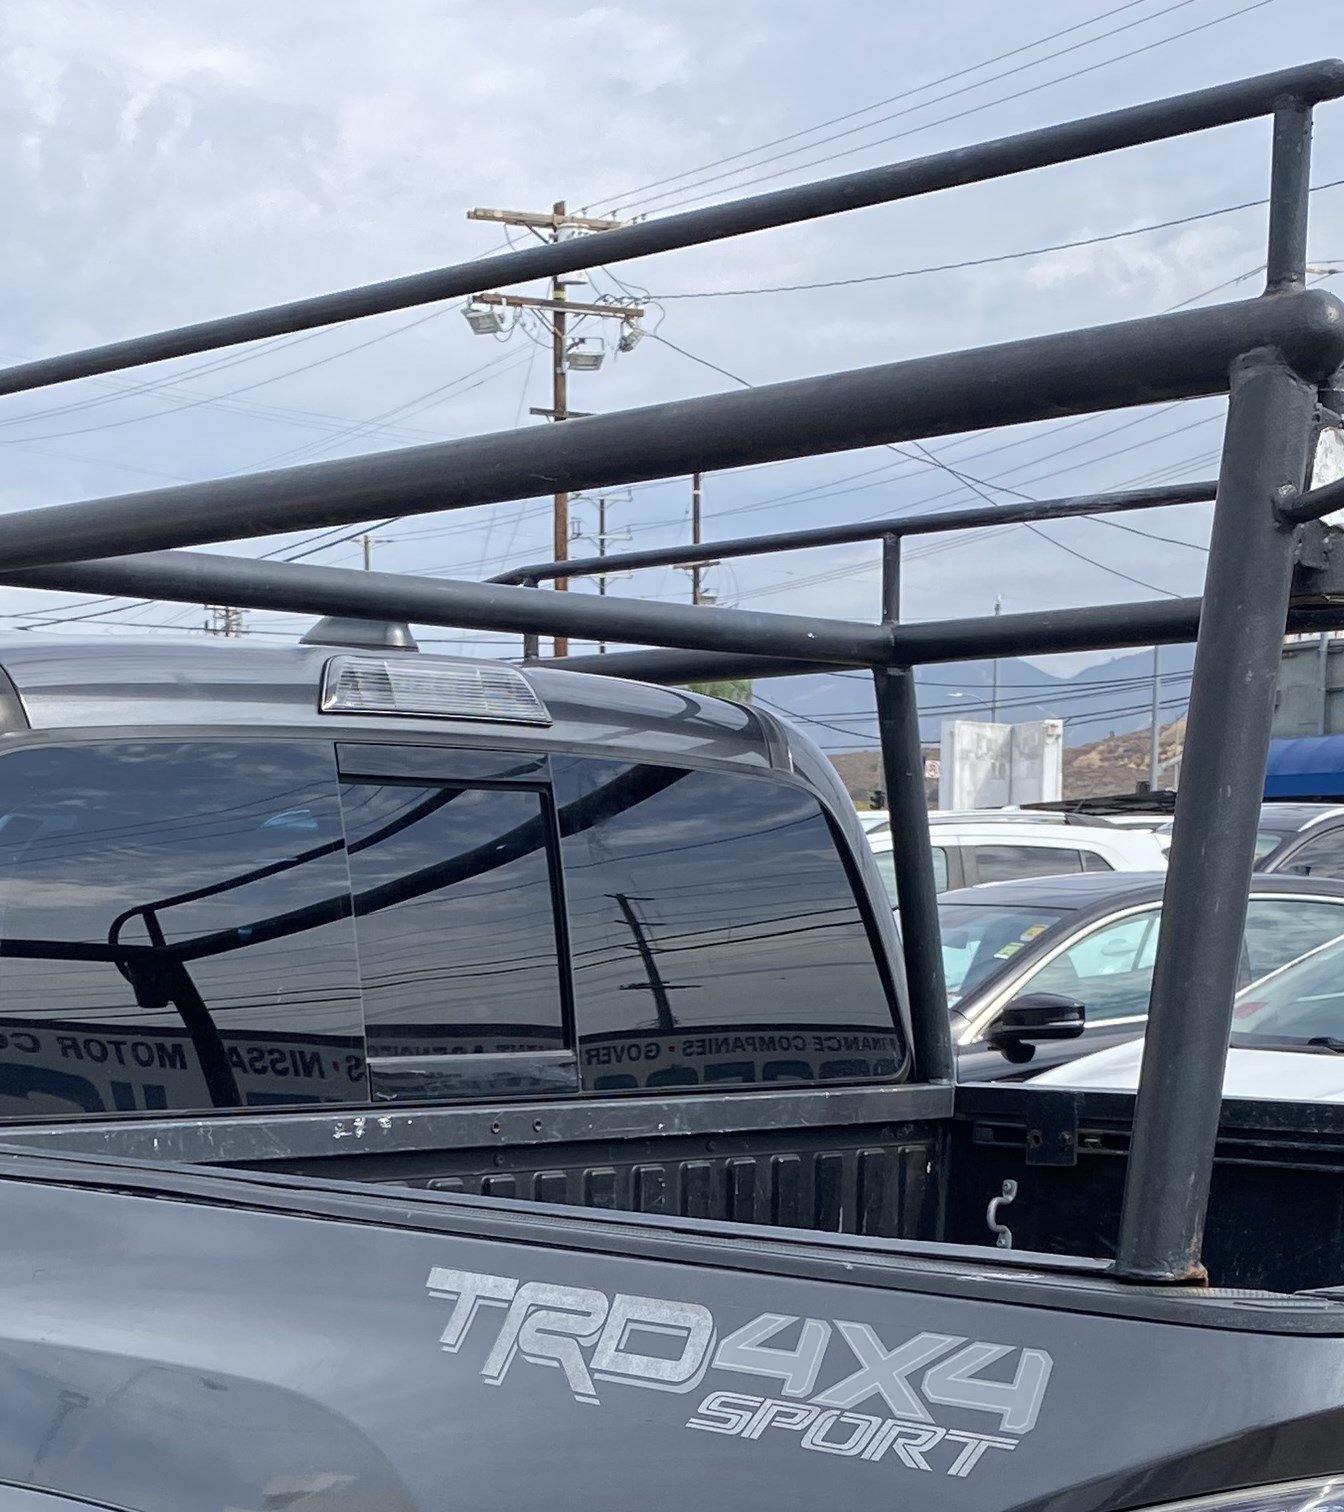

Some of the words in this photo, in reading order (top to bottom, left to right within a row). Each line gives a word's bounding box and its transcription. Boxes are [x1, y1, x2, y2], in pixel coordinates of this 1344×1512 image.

[425, 1266, 719, 1406] TRD
[712, 1311, 1054, 1434] 4X4
[685, 1389, 1020, 1479] SPORT
